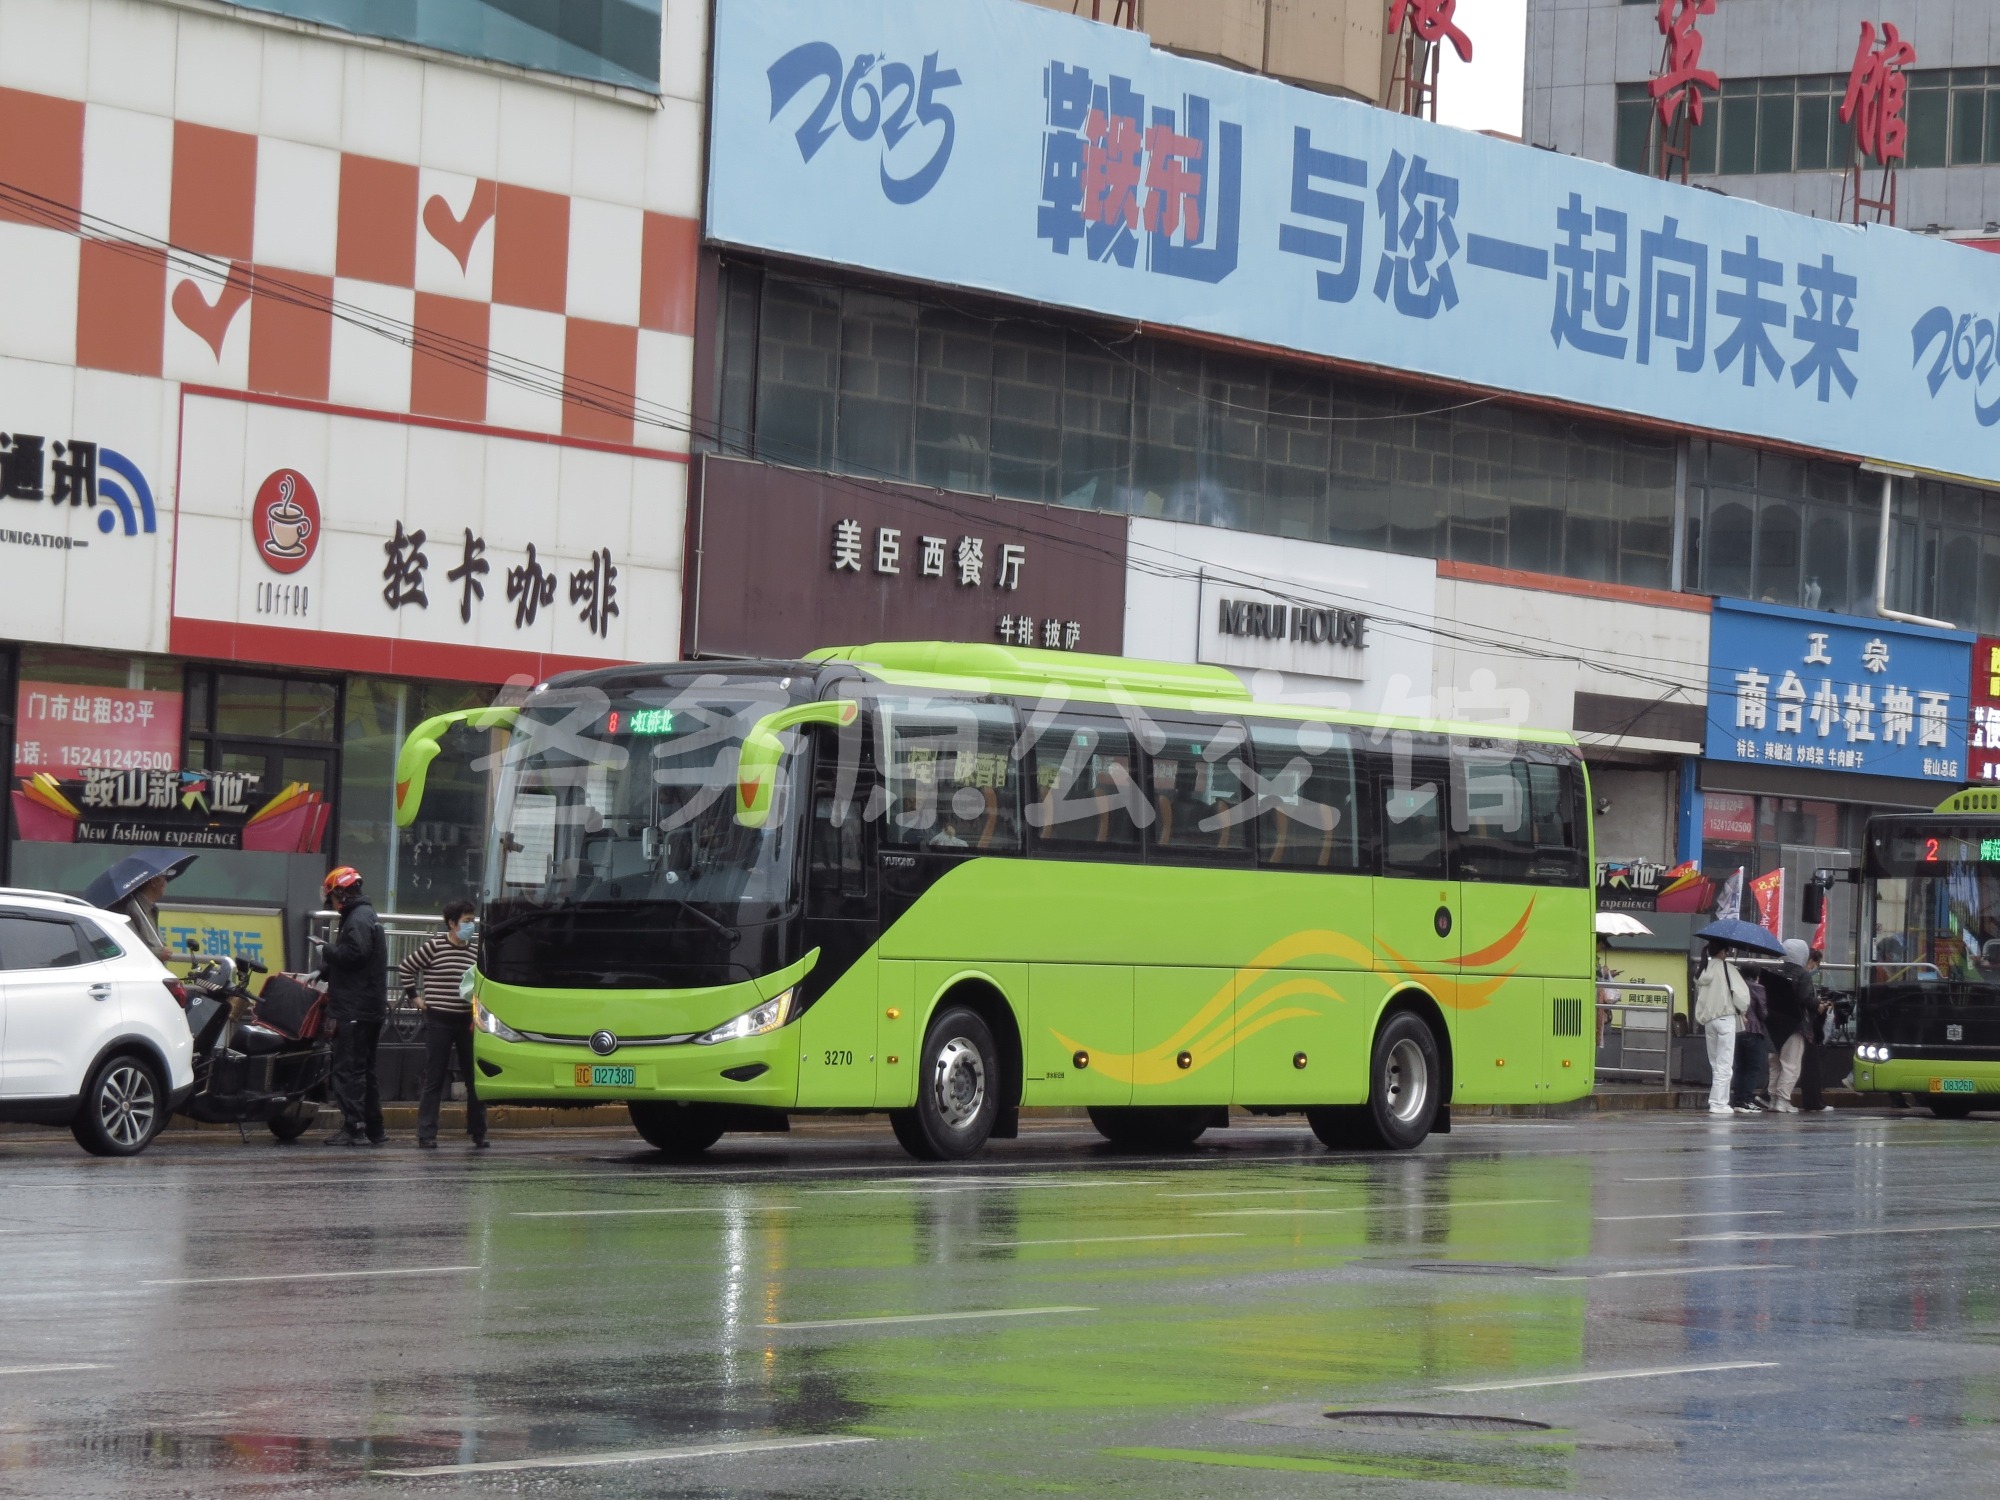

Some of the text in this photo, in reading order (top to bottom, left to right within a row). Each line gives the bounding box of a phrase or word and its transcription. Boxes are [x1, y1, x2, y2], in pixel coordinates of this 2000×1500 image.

[767, 42, 962, 205] 2025
[1081, 108, 1202, 241] 铁东
[833, 519, 1026, 590] 美臣西餐厅
[384, 519, 619, 638] 轻卡咖啡
[998, 614, 1081, 650] 牛排 披萨
[1219, 599, 1370, 649] MERUI HOUSE
[1804, 632, 1890, 673] 正宗
[28, 692, 154, 728] 门市出租33平
[1735, 667, 1950, 748] 南台小杜抻面
[61, 746, 173, 772] 15241242500
[1923, 757, 1958, 778] 鞍山总店
[1926, 838, 1939, 861] 2
[824, 1050, 853, 1065] 3270
